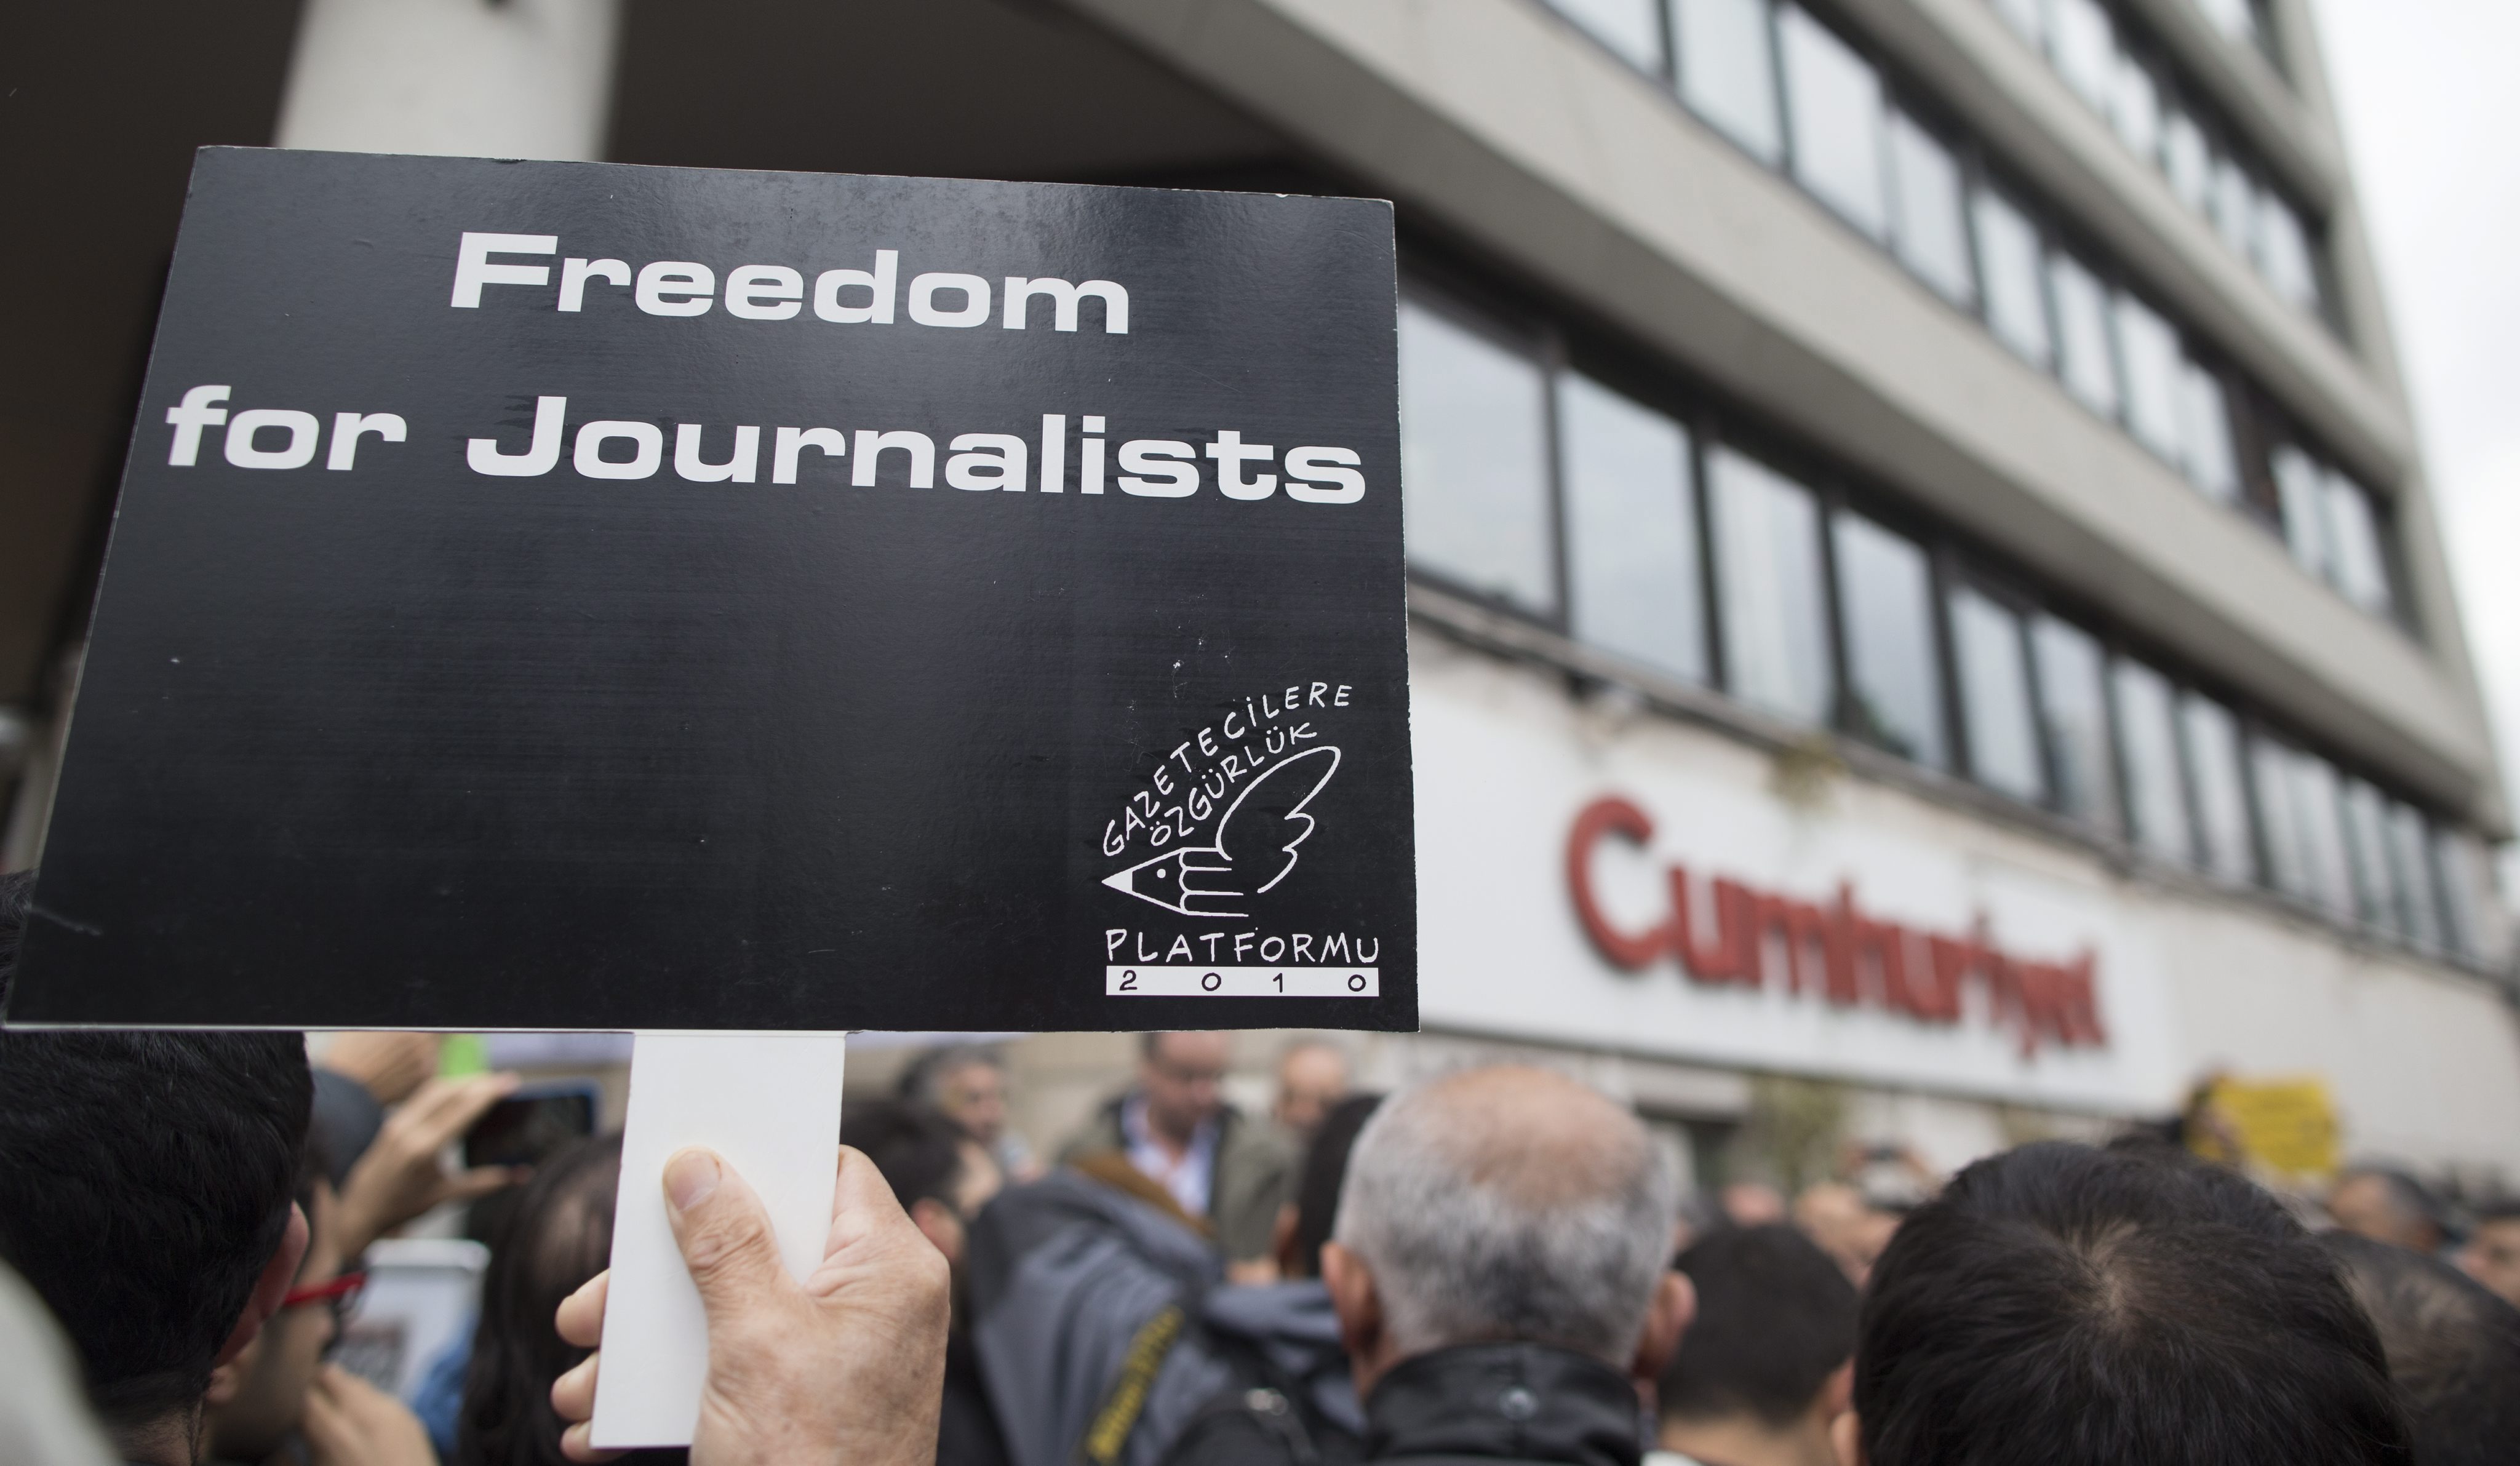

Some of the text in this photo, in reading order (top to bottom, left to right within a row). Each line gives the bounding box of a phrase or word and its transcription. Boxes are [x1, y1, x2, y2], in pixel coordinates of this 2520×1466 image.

[450, 231, 1129, 334] Freedom
[166, 385, 1366, 504] for Journalists
[1103, 682, 1352, 856] GAZETECİLERE
[1149, 722, 1317, 847] ÖZGÜRLÜK
[1106, 928, 1379, 963] PLATFORMU
[1566, 794, 2108, 1061] Cumhuriyet
